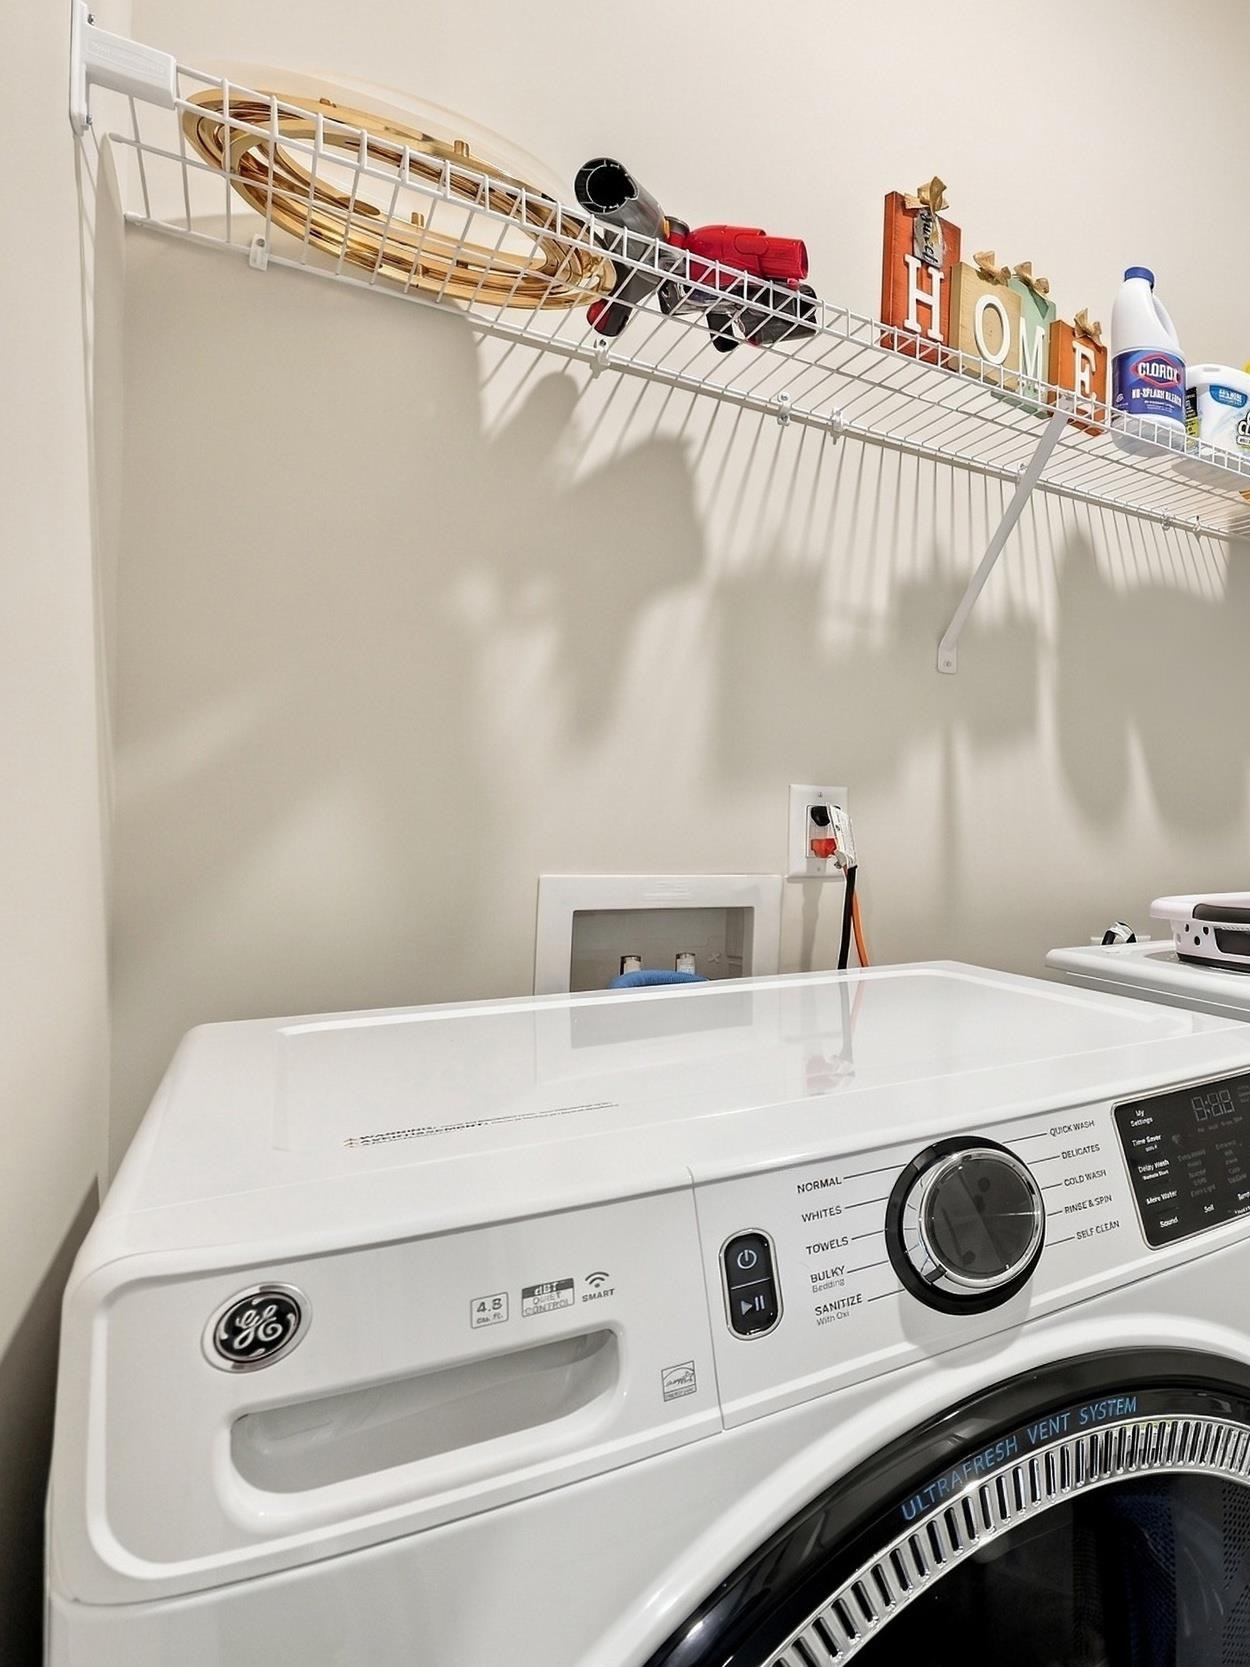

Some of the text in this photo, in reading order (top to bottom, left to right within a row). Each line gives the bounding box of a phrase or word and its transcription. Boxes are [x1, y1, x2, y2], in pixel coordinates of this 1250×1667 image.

[1138, 362, 1178, 383] CLOROX
[1135, 1109, 1145, 1117] My
[1049, 1120, 1095, 1137] QUICK WASH
[1130, 1117, 1153, 1127] Settings
[1131, 1135, 1161, 1146] Time Saver
[1061, 1144, 1101, 1159] DELICATES
[1138, 1159, 1170, 1173] Delay Wash
[797, 1176, 842, 1194] NORMAL
[1064, 1169, 1107, 1186] COLD WASH
[1064, 1194, 1112, 1214] RINSE & SPIN
[1146, 1190, 1177, 1205] More Water
[801, 1205, 842, 1222] WHITES
[1076, 1220, 1120, 1240] SELF CLEAN
[1160, 1217, 1179, 1228] Sound
[805, 1236, 849, 1255] TOWELS
[810, 1265, 845, 1283] BULKY
[812, 1278, 845, 1293] Bedding
[582, 1288, 615, 1302] SMART
[524, 1299, 569, 1315] CONTROL
[815, 1293, 862, 1316] SANITIZE
[816, 1310, 850, 1326] With Oxi
[233, 1305, 283, 1349] GE
[901, 1396, 1137, 1521] ULTRAFRESH VENT SYSTEM
